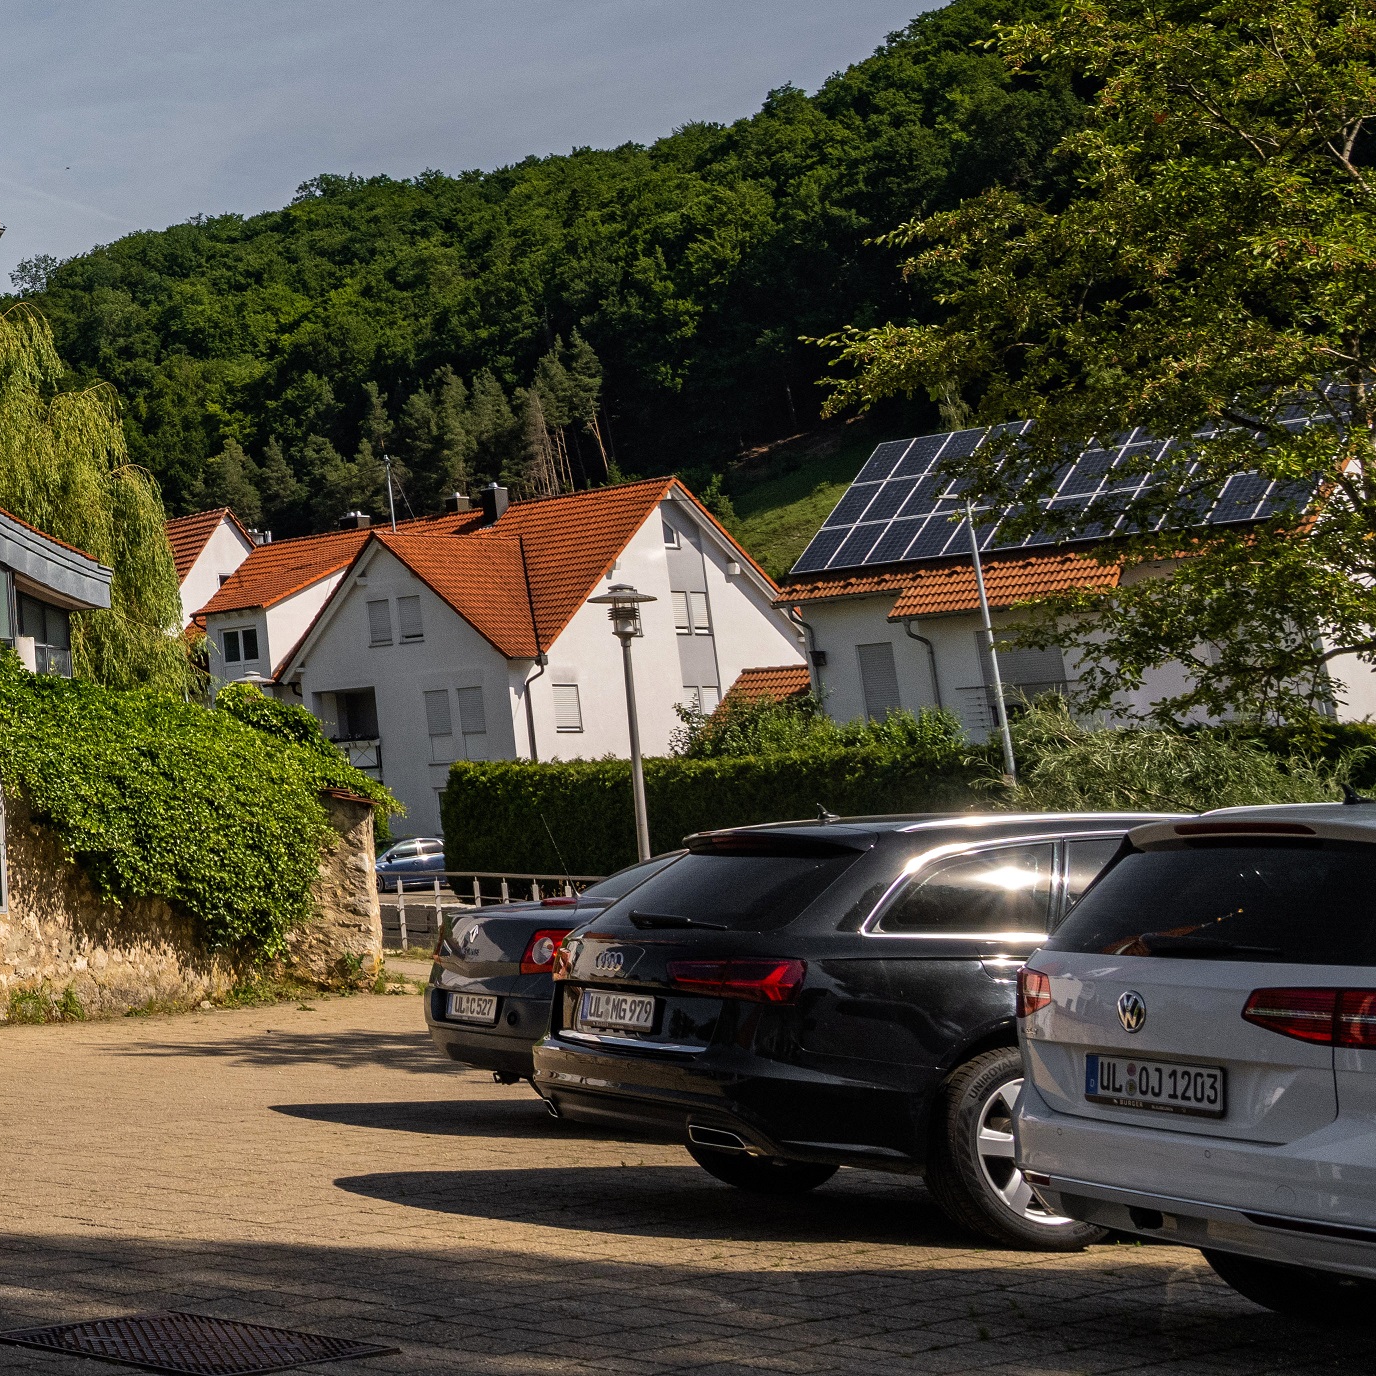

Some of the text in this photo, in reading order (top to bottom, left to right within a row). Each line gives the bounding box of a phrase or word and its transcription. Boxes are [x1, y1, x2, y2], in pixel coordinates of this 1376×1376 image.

[454, 996, 493, 1016] UL C 527
[589, 995, 652, 1022] UL MG 979
[1100, 1061, 1218, 1104] UL OJ 1203
